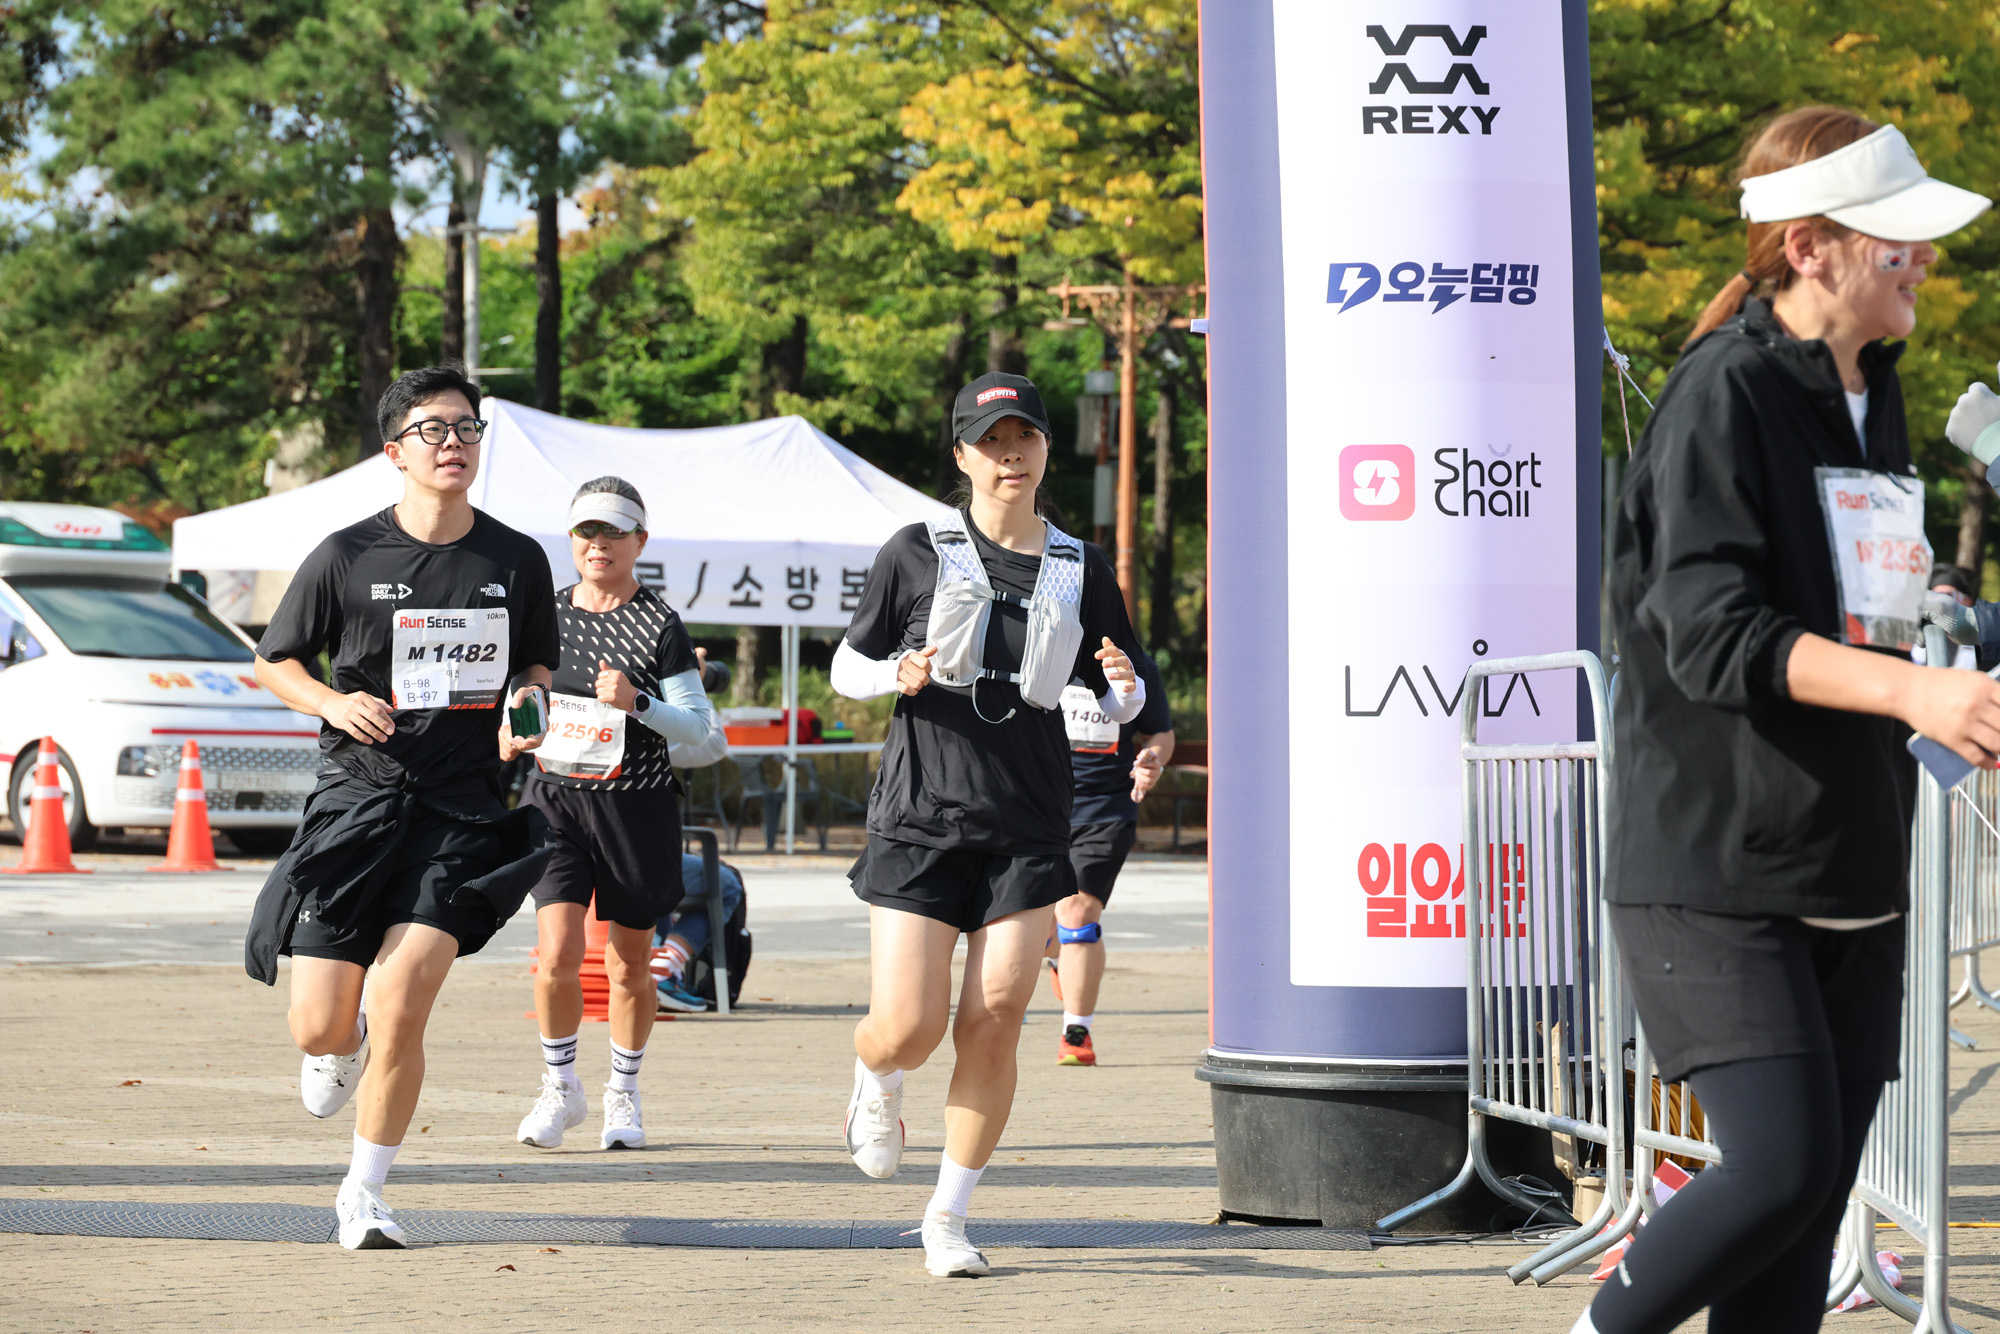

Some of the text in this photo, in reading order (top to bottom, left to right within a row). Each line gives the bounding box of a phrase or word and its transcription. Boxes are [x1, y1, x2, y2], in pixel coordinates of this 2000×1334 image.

[1362, 105, 1501, 135] REXY
[976, 389, 1017, 403] Supreme
[1434, 444, 1542, 488] Short
[1836, 490, 1869, 510] Run
[1856, 539, 1874, 563] W
[400, 616, 467, 629] Run SENSE
[408, 643, 498, 663] M 1482
[403, 679, 430, 688] B-98
[407, 691, 438, 703] B-97
[548, 699, 587, 712] un SENSE
[562, 722, 614, 743] 2506
